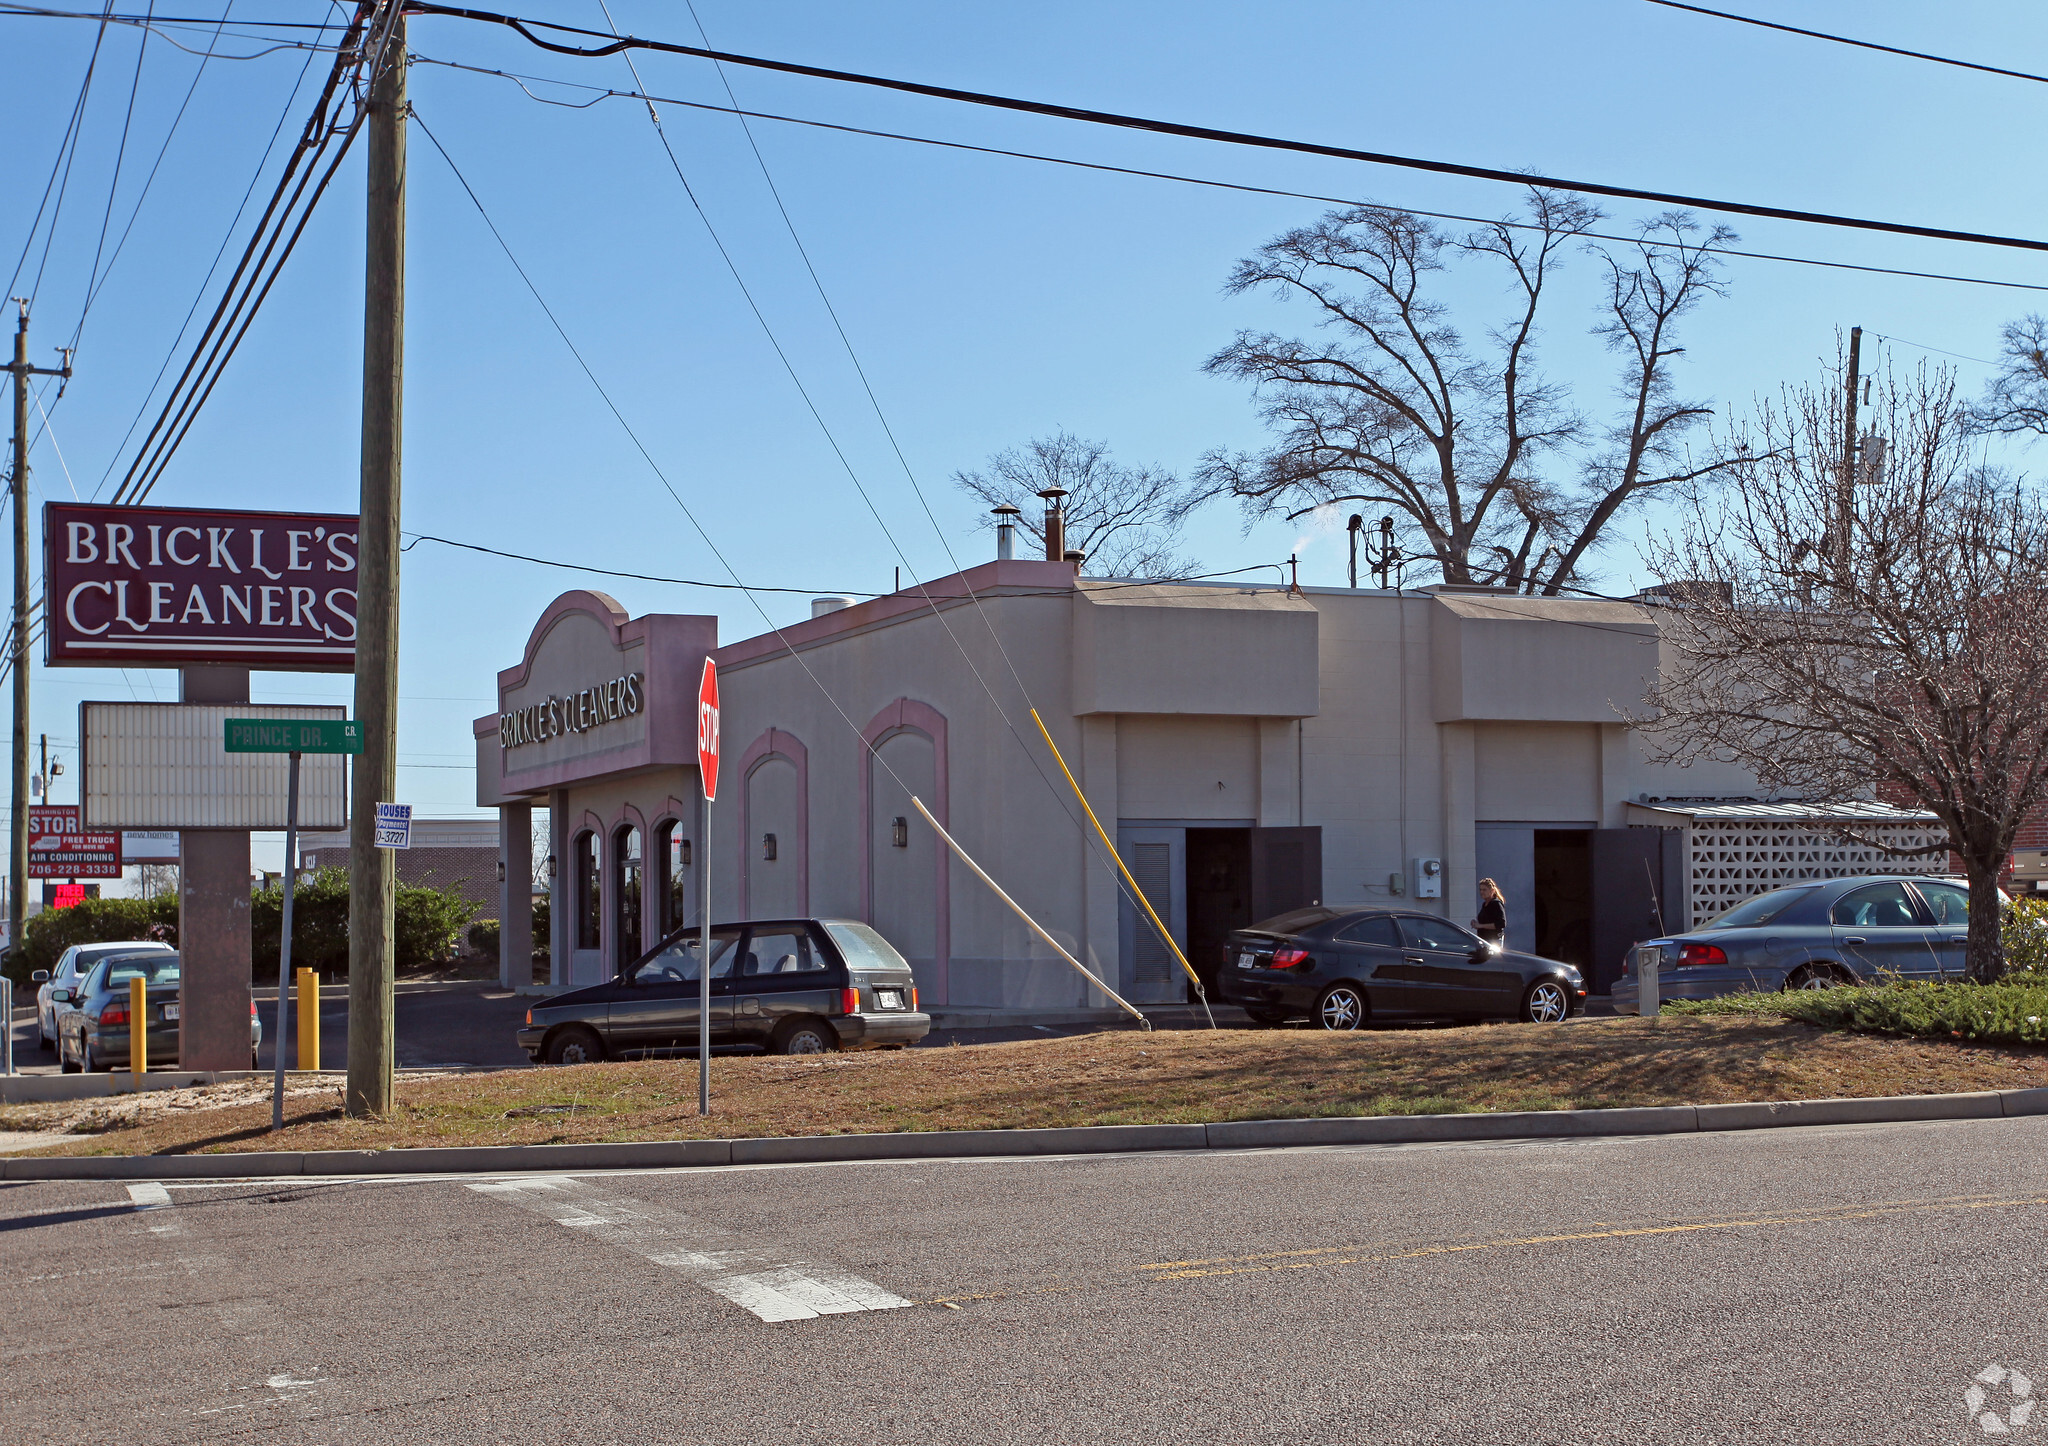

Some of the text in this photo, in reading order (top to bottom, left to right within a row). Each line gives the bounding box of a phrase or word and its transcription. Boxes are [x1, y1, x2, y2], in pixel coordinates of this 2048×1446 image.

[66, 521, 358, 580] BRICKLE'S
[65, 580, 358, 642] CLEANERS
[500, 672, 643, 749] BRICKLE'S CLEANERS
[232, 725, 292, 746] PRINCE
[700, 701, 719, 756] STOP
[29, 808, 77, 816] WASHINGTON
[62, 836, 84, 844] FREE
[87, 836, 115, 844] TRUCK
[31, 853, 46, 862] AIR
[50, 853, 114, 862] CONDITIONING
[29, 865, 116, 875] 706-228-3338
